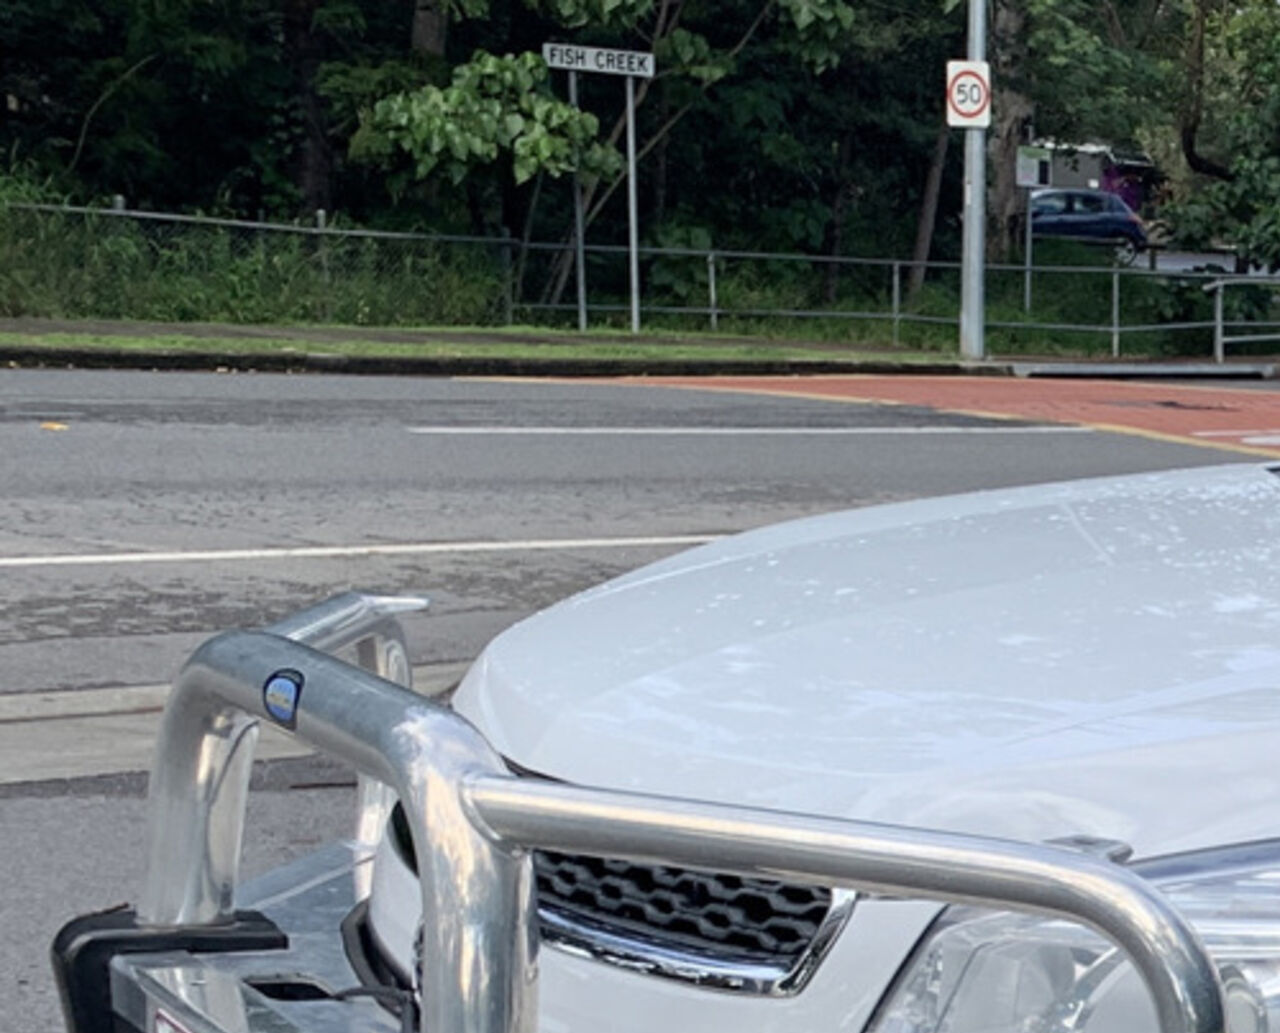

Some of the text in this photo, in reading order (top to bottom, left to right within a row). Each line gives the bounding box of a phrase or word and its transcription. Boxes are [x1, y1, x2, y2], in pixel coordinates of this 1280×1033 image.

[549, 46, 649, 73] FISH CREEK
[956, 83, 982, 105] 50
